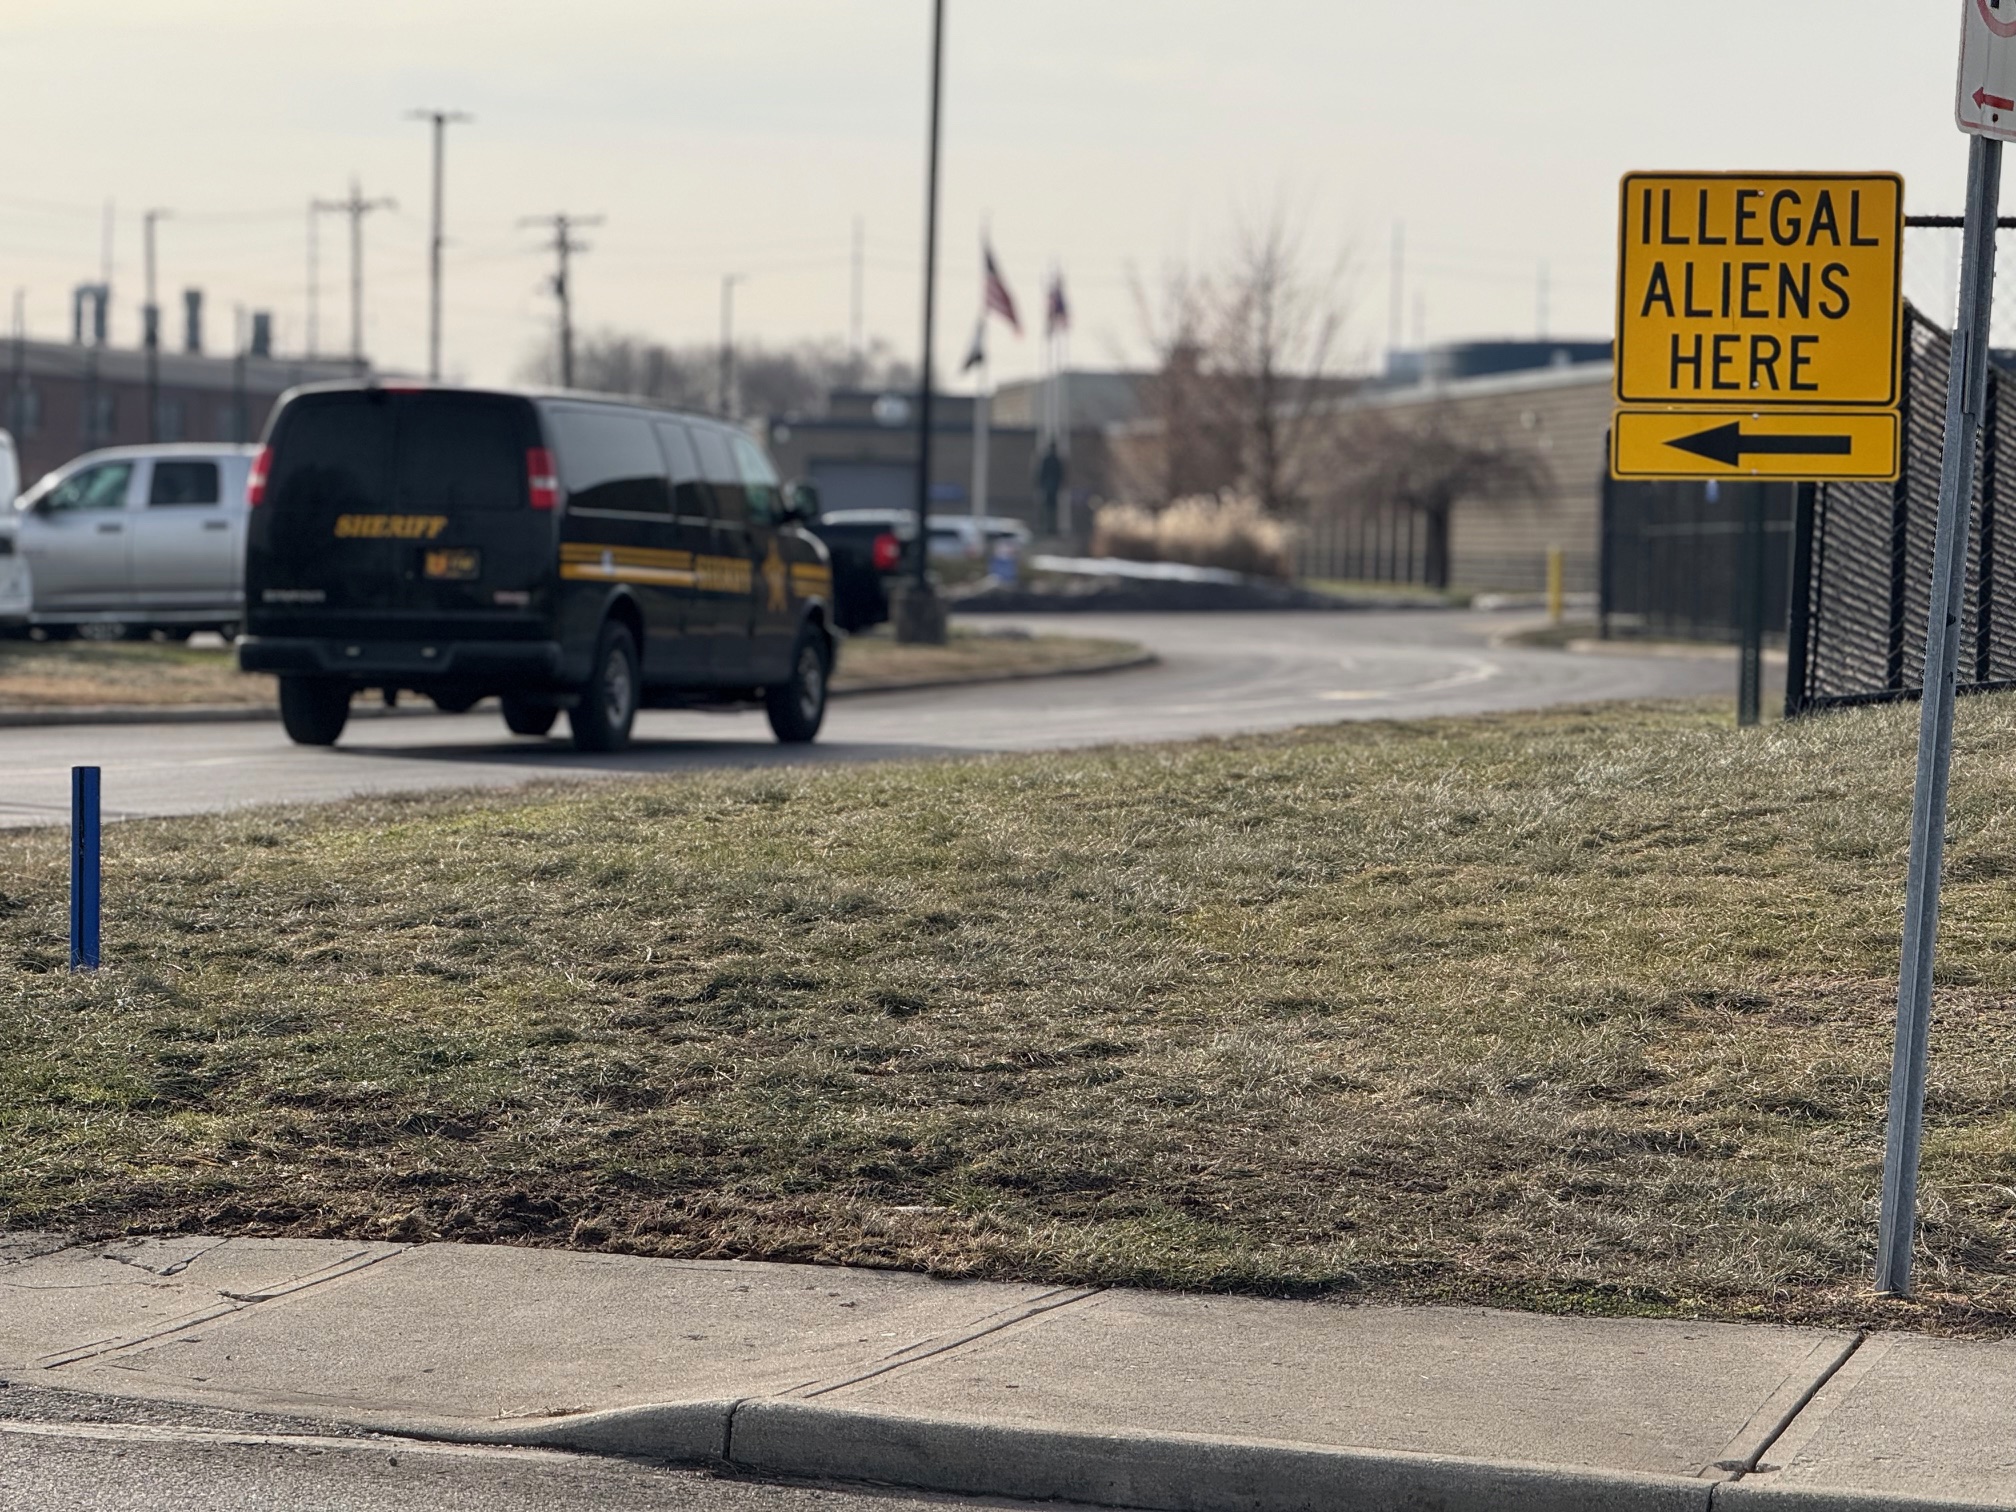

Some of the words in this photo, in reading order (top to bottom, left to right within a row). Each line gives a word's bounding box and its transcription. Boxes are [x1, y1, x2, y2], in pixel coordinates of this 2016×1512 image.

[1642, 188, 1879, 246] ILLEGAL
[1640, 261, 1850, 319] ALIENS
[1670, 333, 1819, 391] HERE
[334, 514, 448, 538] SHERIFF
